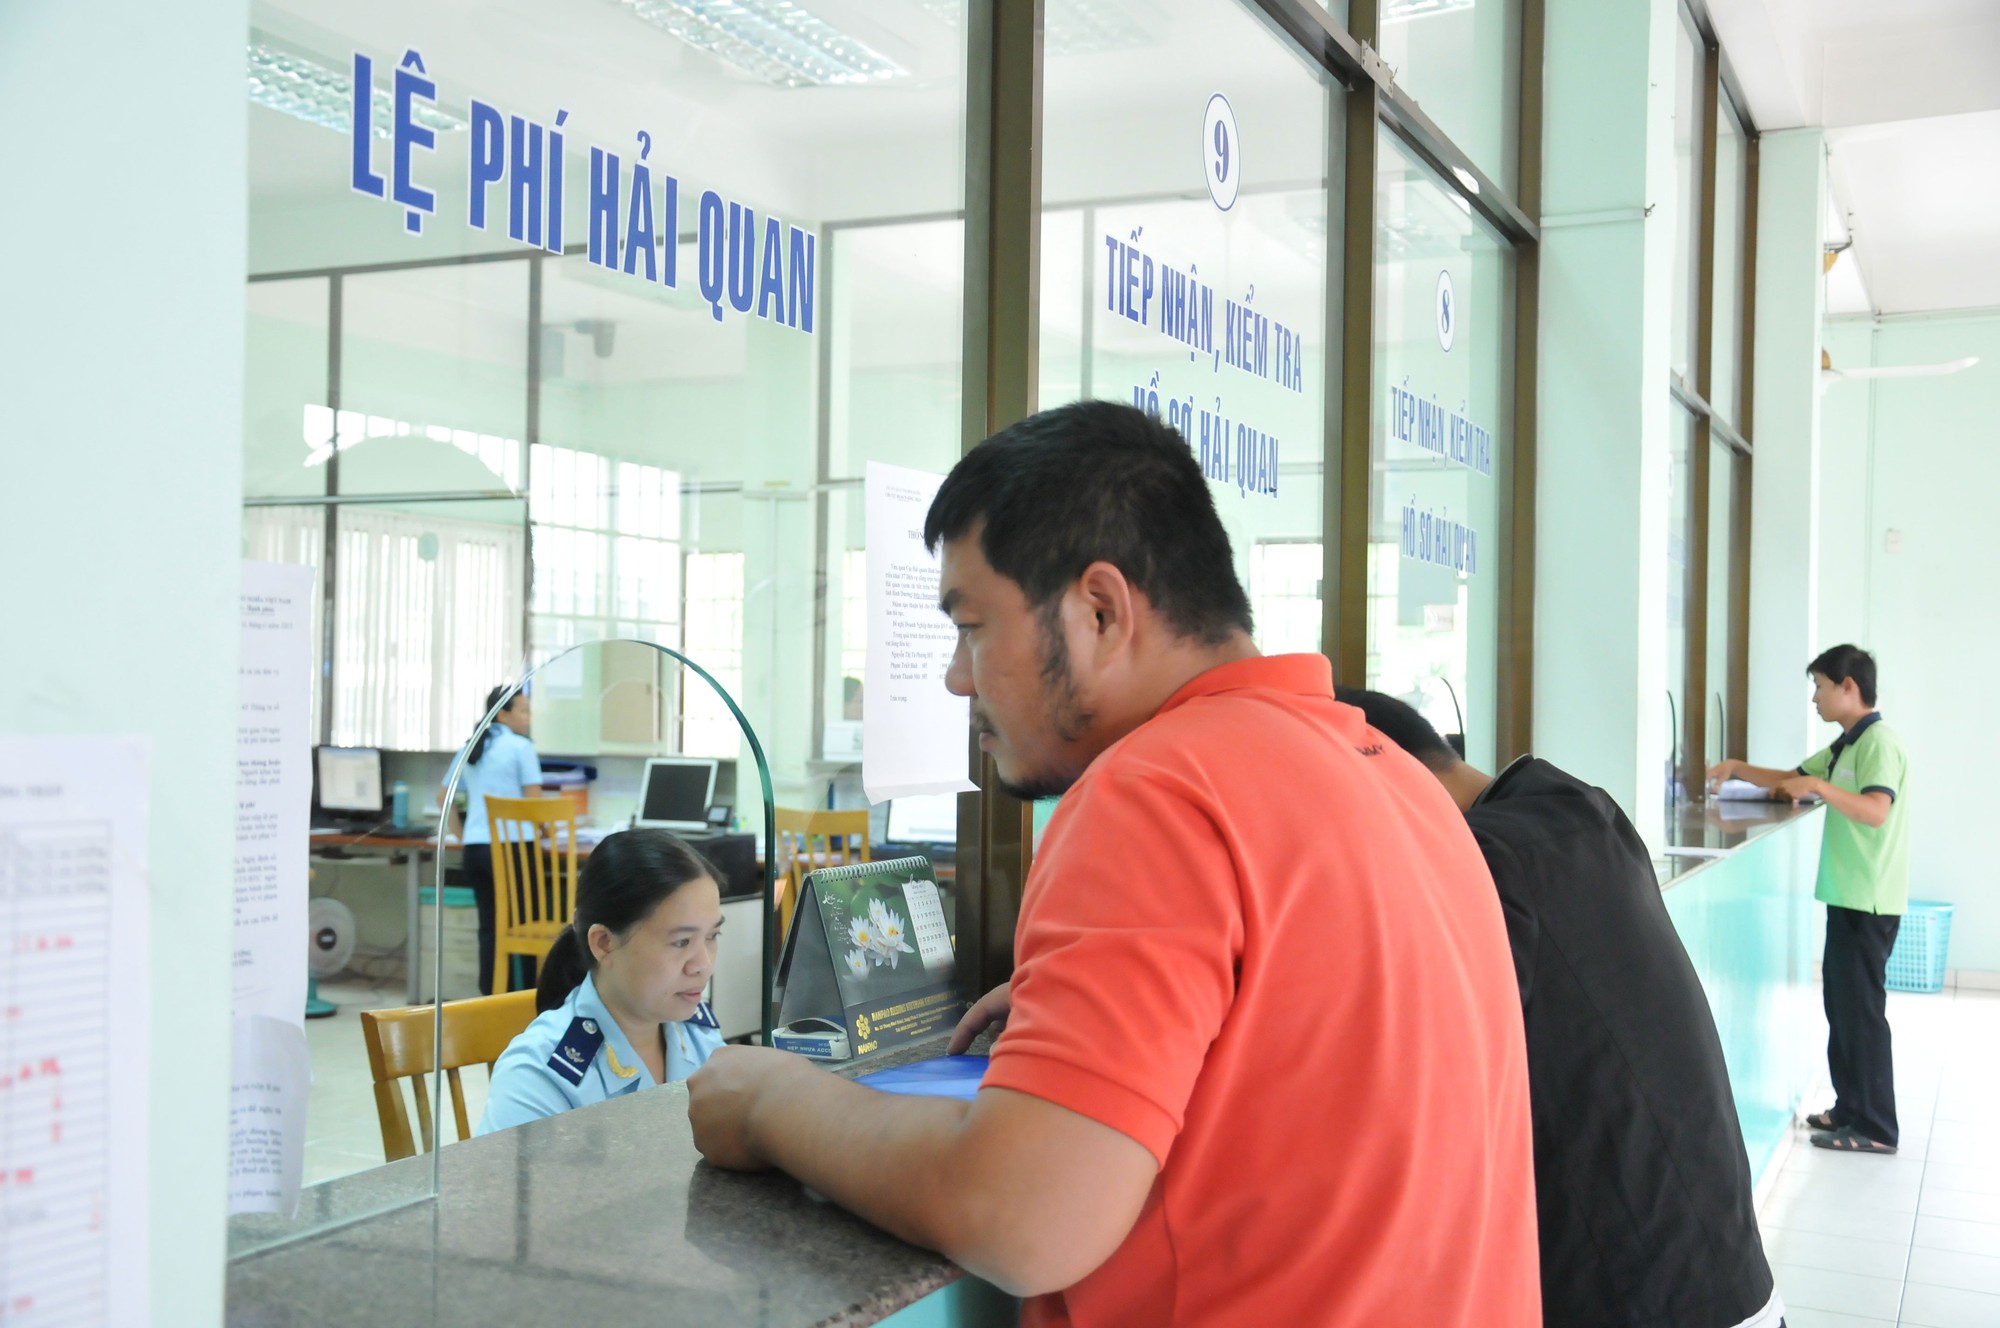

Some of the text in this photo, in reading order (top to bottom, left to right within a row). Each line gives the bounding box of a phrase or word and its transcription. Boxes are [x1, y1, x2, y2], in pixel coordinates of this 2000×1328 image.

[352, 49, 816, 335] LỆ PHÍ HẢI QUAN
[1214, 119, 1230, 184] 9
[1106, 226, 1154, 326] TIẾP
[1225, 284, 1268, 379] KIỂM
[1274, 322, 1303, 394] TRA
[1441, 288, 1450, 334] 8
[1201, 396, 1230, 484] HẢI
[1237, 422, 1279, 499] QUAN
[1392, 375, 1415, 443] TIẾP
[1450, 399, 1473, 468] KIỂM
[1475, 426, 1490, 477] TRA
[1402, 493, 1477, 577] HỒ SƠ HẢI QUAN
